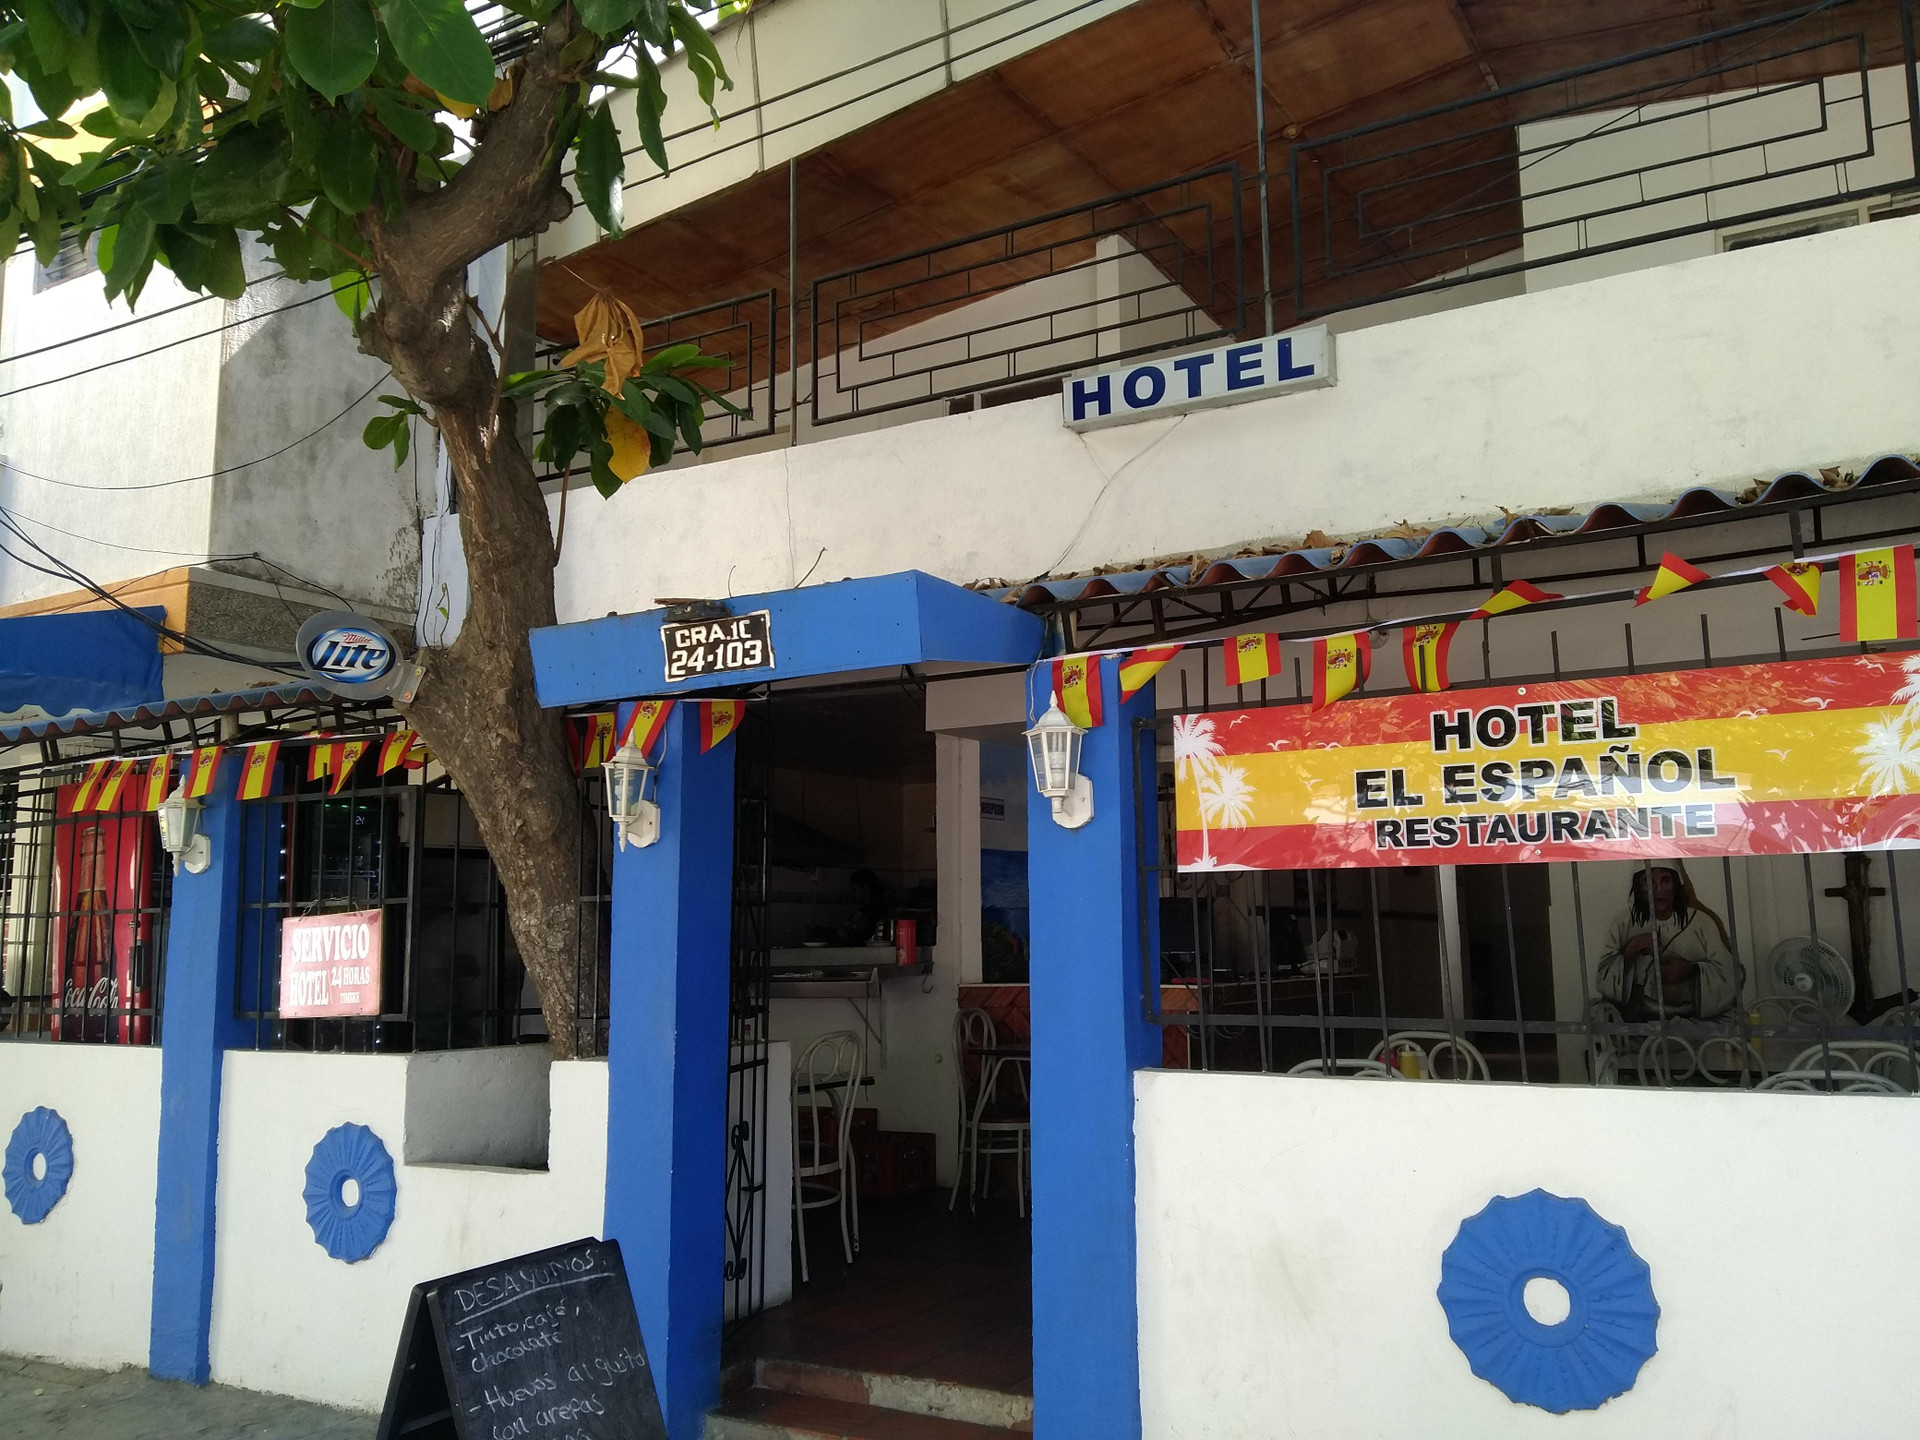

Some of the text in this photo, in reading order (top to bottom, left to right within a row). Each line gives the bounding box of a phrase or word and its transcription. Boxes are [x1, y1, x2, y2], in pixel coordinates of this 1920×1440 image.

[1072, 337, 1315, 421] HOTEL
[341, 631, 373, 644] Miller
[311, 640, 387, 673] Lite
[1431, 697, 1638, 752] HOTEL
[1355, 744, 1737, 809] EL ESPAÑOL
[1375, 802, 1716, 849] RESTAURANTE
[292, 924, 369, 962] SERVICIO
[289, 970, 329, 1006] HOTEL
[332, 965, 370, 988] 24 HORAS
[568, 1362, 594, 1381] al
[536, 1393, 605, 1426] arepas
